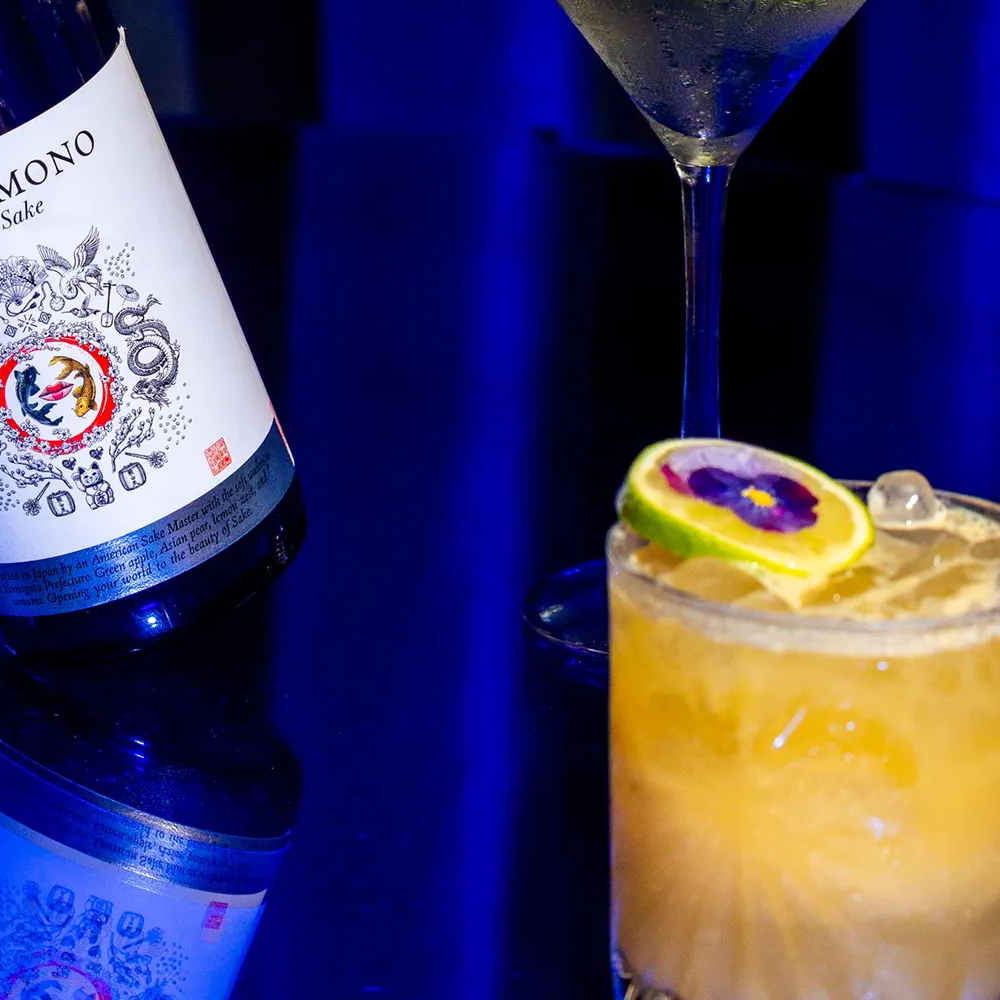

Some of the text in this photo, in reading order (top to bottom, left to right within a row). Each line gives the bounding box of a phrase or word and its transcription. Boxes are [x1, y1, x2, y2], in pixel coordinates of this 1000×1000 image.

[1, 200, 45, 230] Sake
[1, 582, 43, 597] Yamagata
[43, 572, 94, 592] Prefecture.
[94, 561, 126, 579] Green
[128, 548, 159, 570] apple,
[160, 534, 189, 554] Asian
[189, 521, 212, 543] pear,
[211, 502, 239, 525] lemon
[240, 487, 257, 506] zest,
[21, 569, 31, 580] in
[32, 566, 59, 582] Japan
[60, 562, 73, 575] by
[76, 558, 89, 570] an
[91, 542, 139, 565] American
[140, 529, 166, 547] Sake
[166, 511, 200, 535] Master
[201, 494, 221, 516] with
[221, 488, 234, 503] the
[234, 472, 248, 493] soft
[46, 589, 91, 606] Opening
[93, 578, 118, 598] your
[121, 563, 153, 584] world
[155, 560, 167, 572] to
[170, 549, 187, 566] the
[187, 531, 220, 555] beauty
[221, 518, 231, 538] of
[231, 508, 253, 528] Sake.
